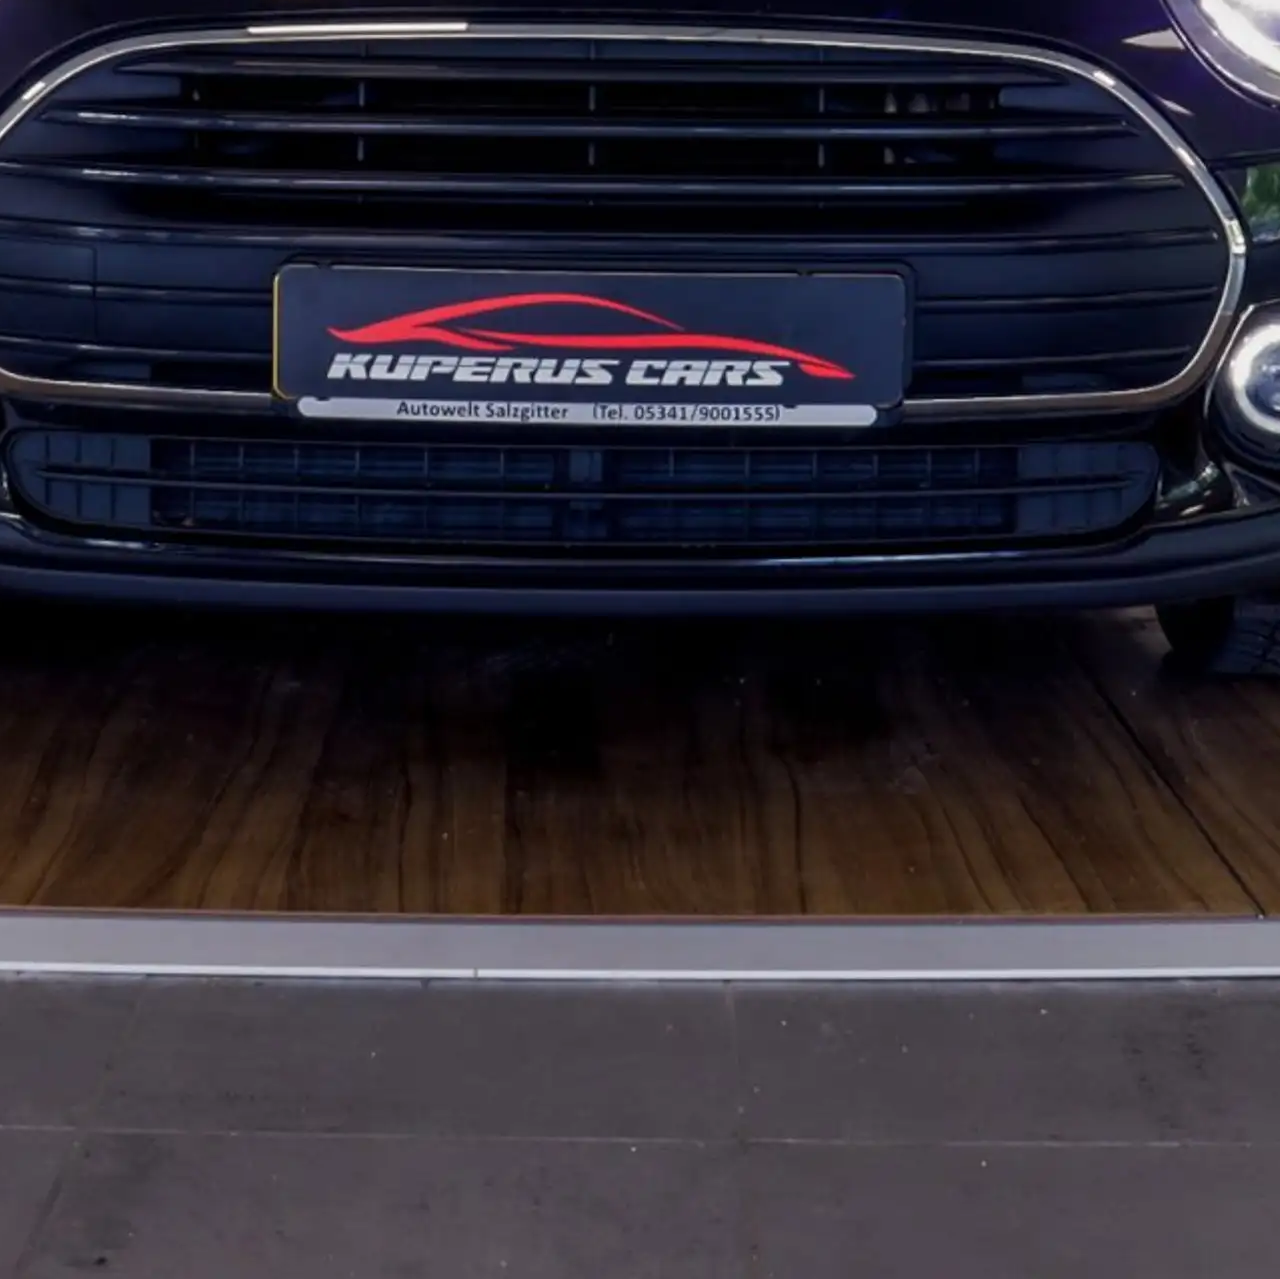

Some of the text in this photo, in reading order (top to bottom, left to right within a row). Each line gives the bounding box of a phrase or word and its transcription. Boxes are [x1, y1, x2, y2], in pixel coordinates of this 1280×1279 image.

[327, 353, 790, 386] KUPERUS CARS
[396, 401, 781, 422] Autowelt Salzgitter (Tel. 05341/9001555)
